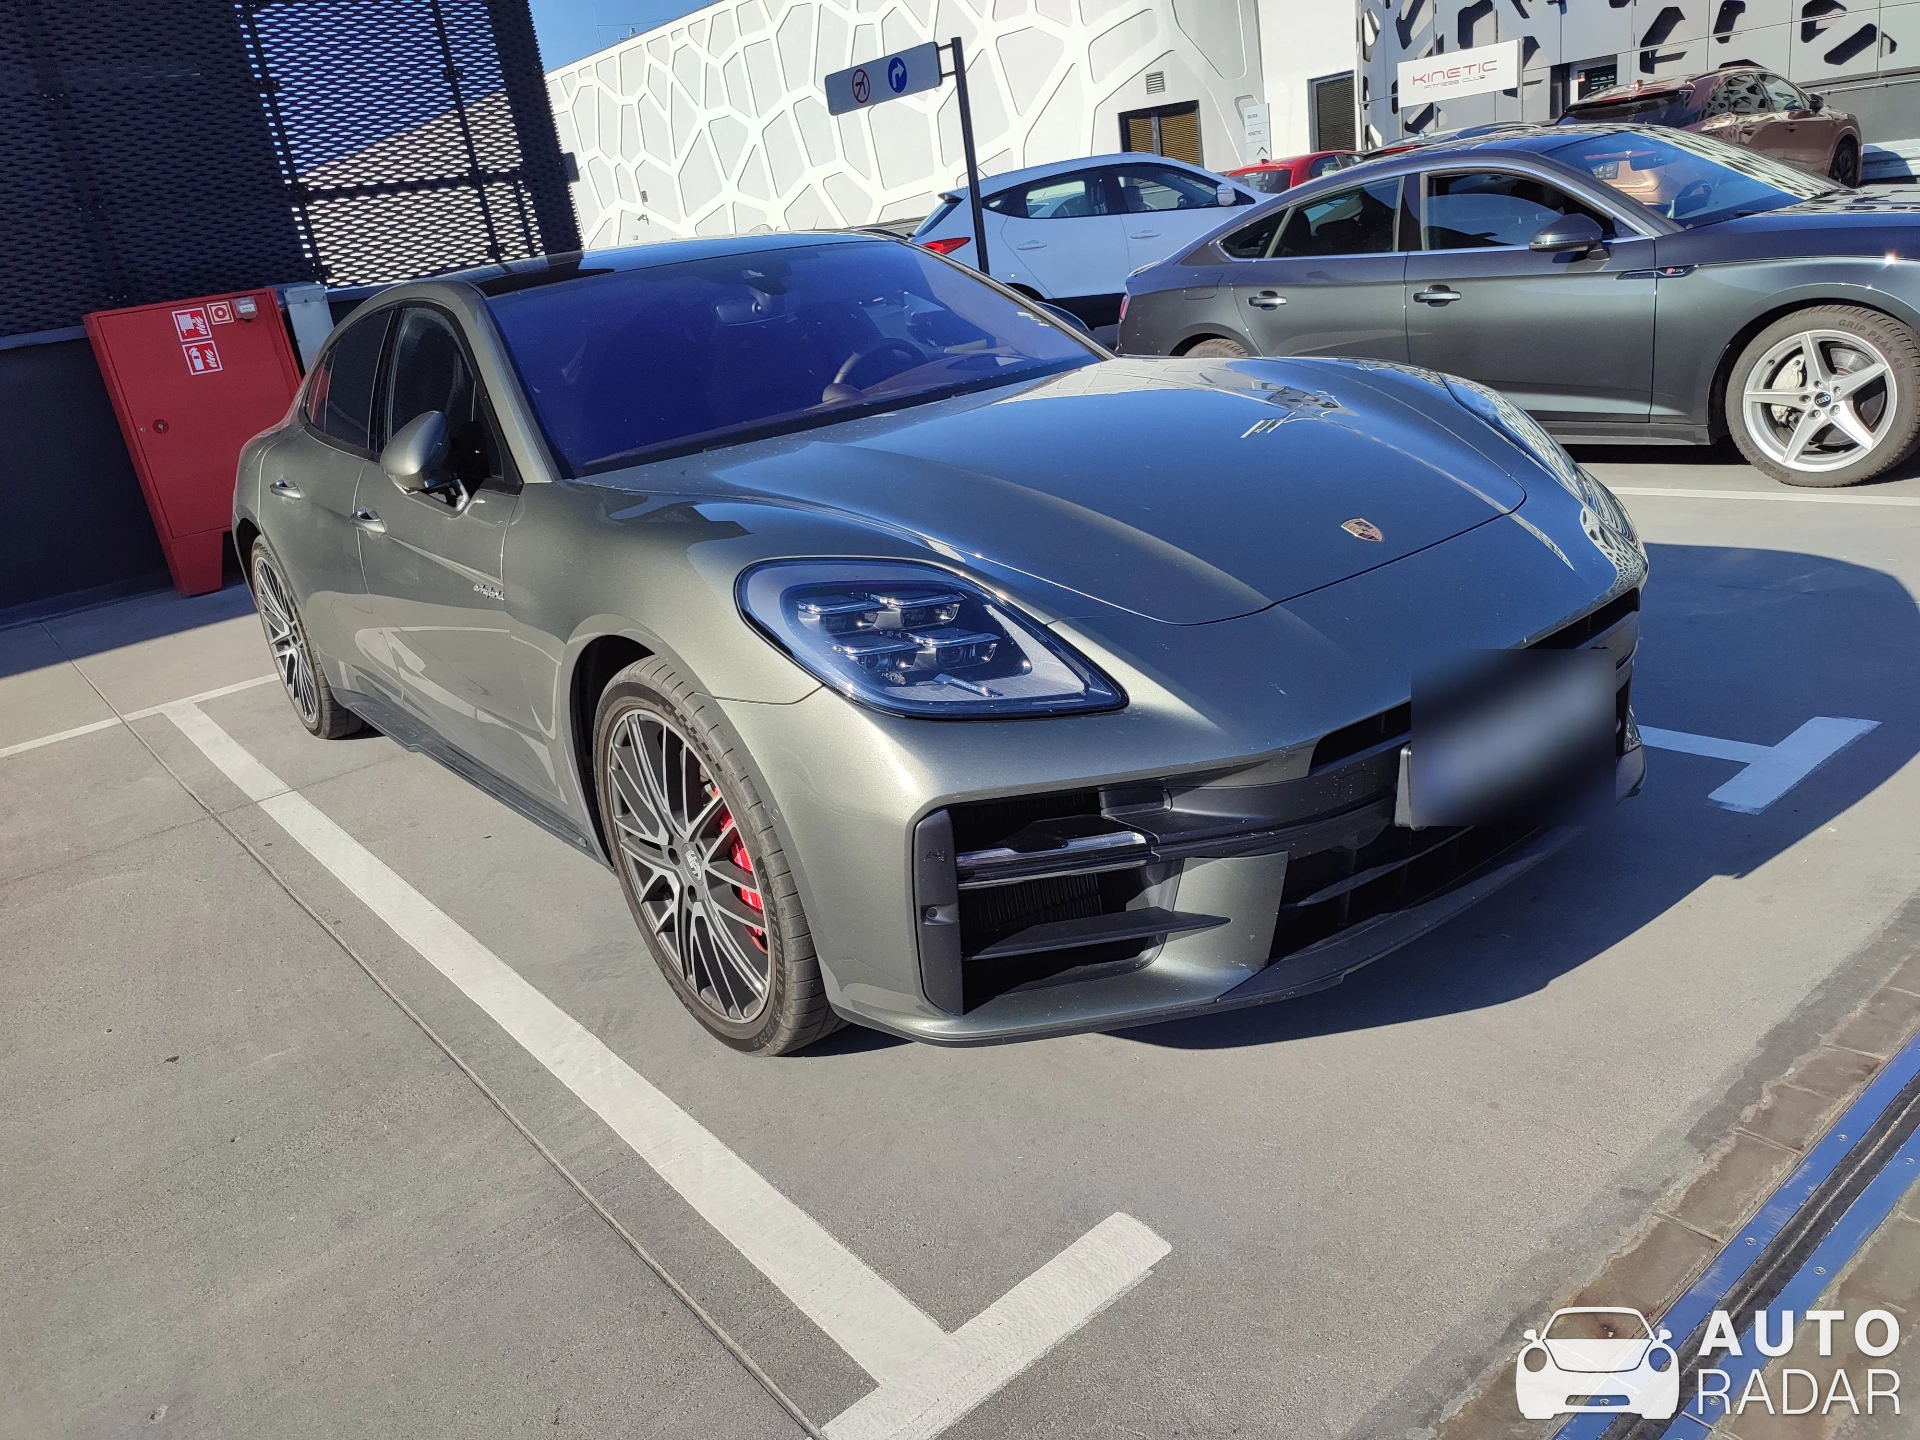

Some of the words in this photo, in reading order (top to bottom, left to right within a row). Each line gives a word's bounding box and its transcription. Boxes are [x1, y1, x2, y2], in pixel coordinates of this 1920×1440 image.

[1412, 60, 1498, 85] KINETIC
[1424, 79, 1460, 90] FITNESS
[1461, 74, 1486, 83] CLUB
[1838, 319, 1866, 332] GRIP
[1867, 329, 1896, 355] PEAK
[764, 893, 785, 996] MICHELIN
